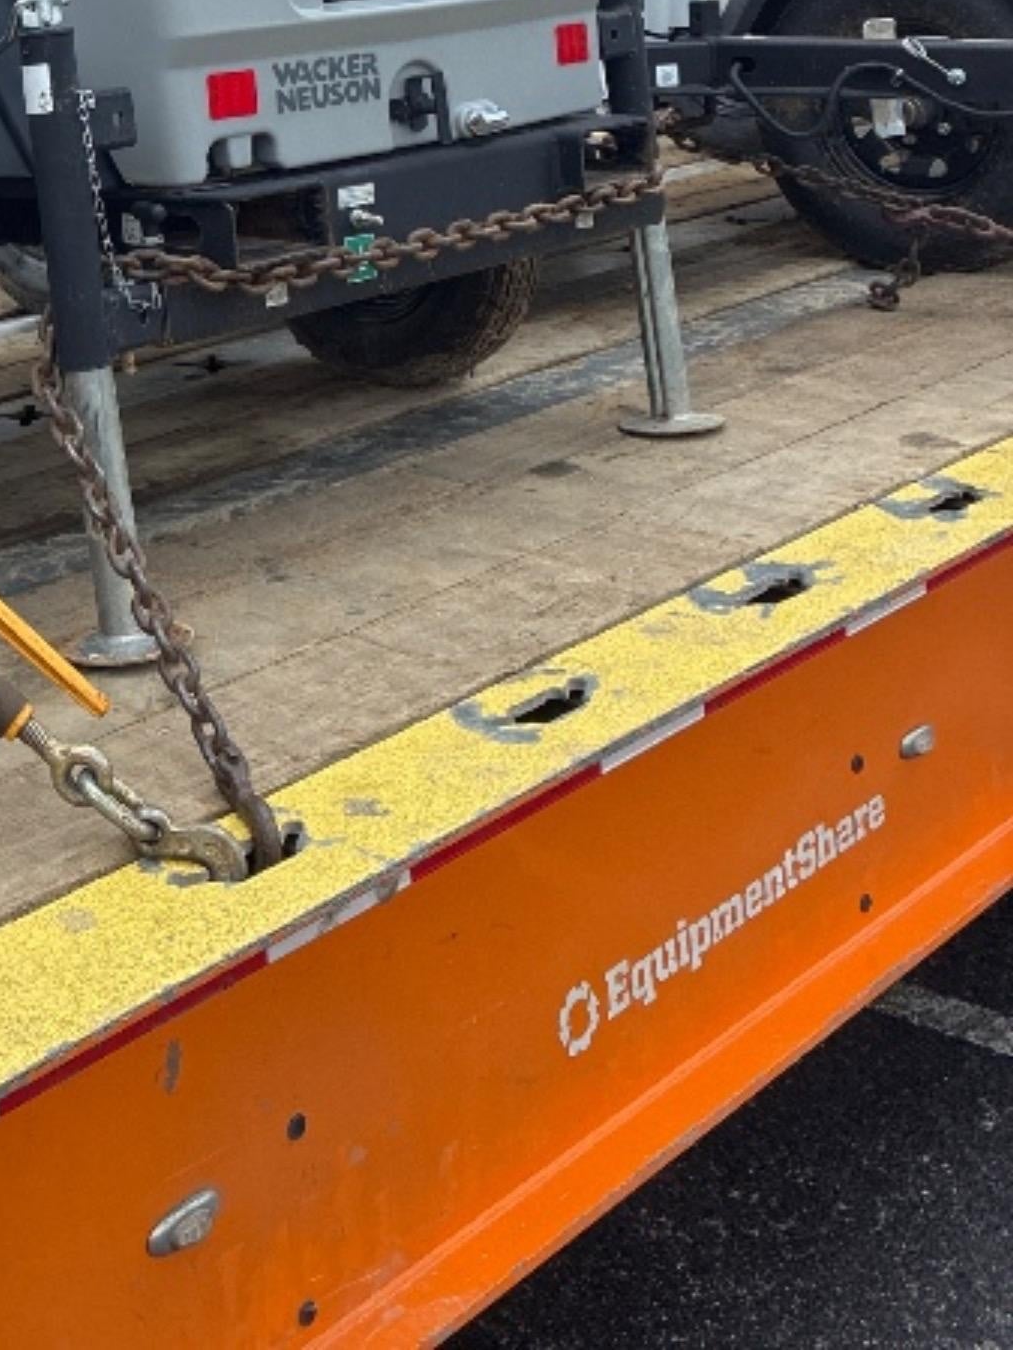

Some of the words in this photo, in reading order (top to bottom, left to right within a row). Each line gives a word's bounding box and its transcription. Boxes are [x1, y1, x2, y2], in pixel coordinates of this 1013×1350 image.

[272, 53, 379, 87] WACKER
[275, 77, 382, 114] NEUSON
[604, 793, 886, 1021] EquipmentShare
